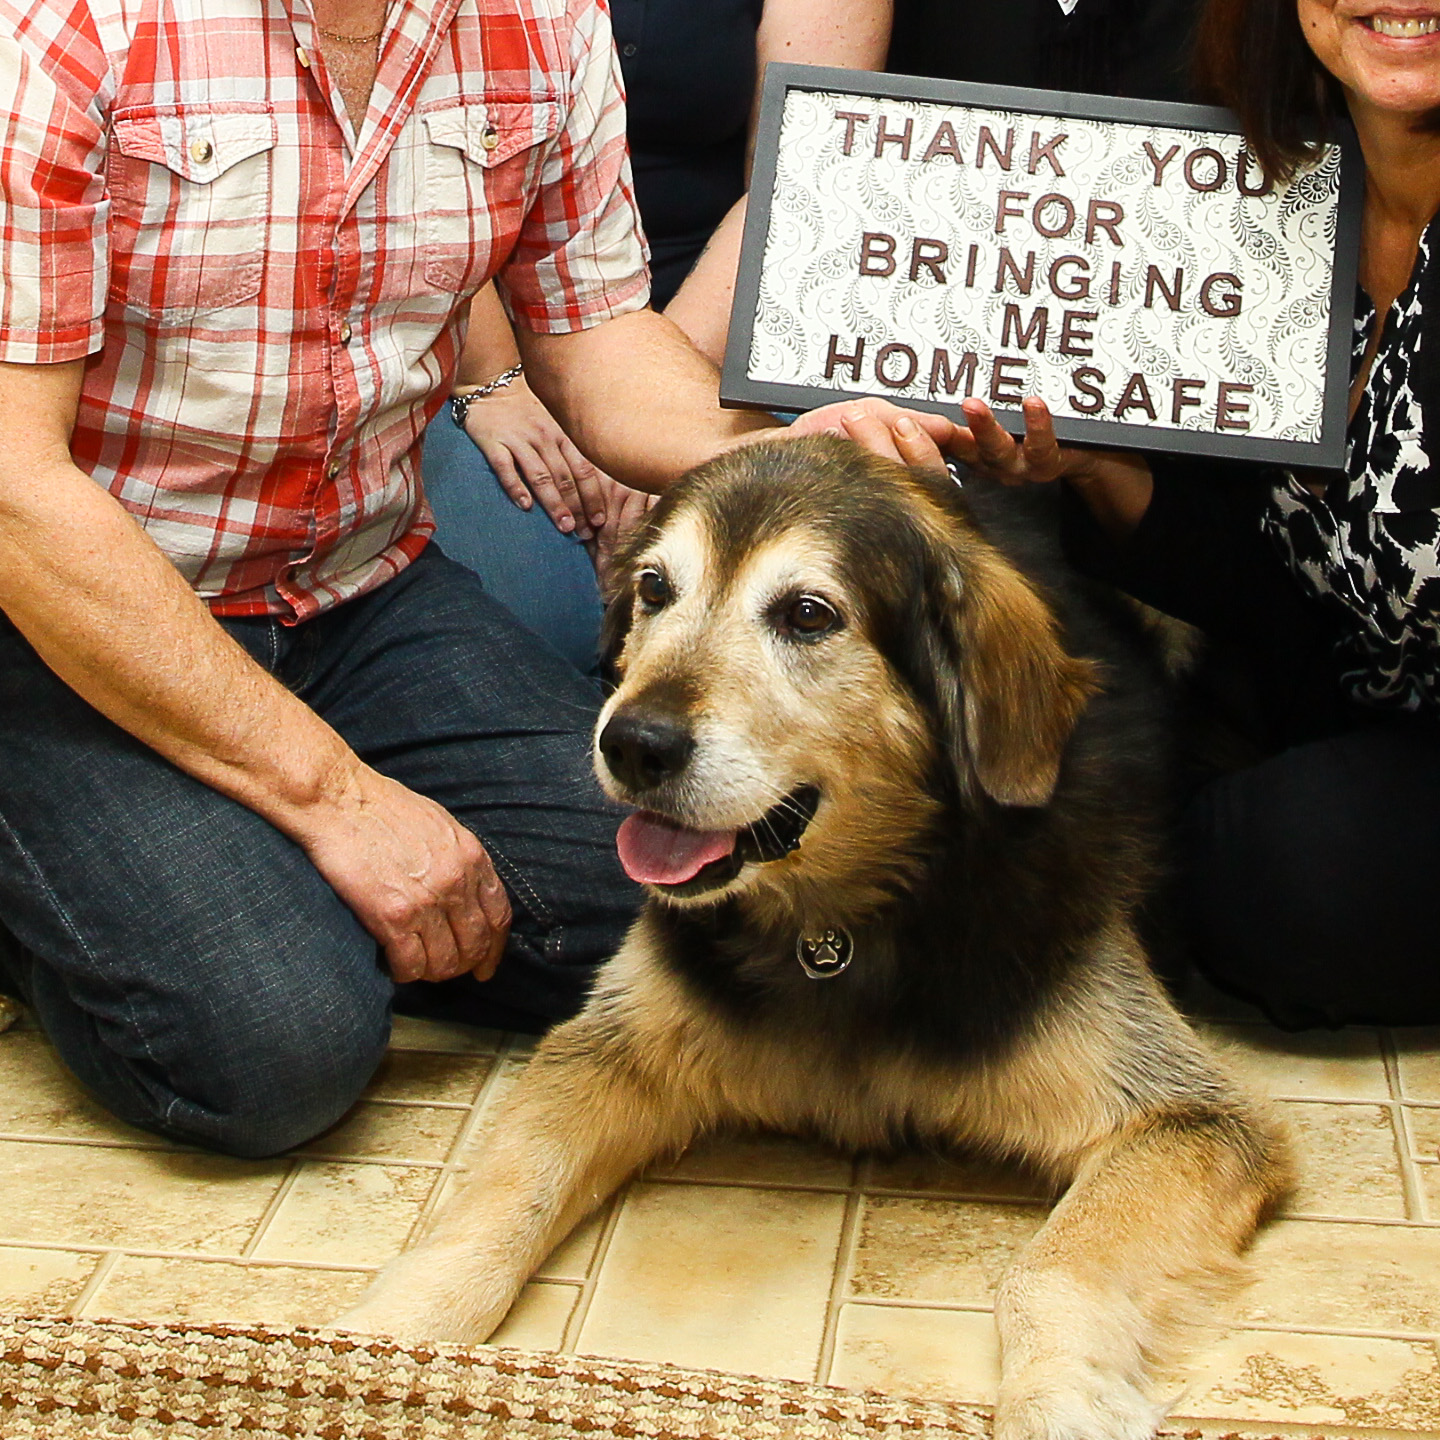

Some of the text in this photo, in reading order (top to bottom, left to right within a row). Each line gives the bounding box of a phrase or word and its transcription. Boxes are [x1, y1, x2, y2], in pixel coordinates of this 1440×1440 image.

[833, 111, 1276, 197] THANK YOU
[994, 191, 1125, 247] FOR
[858, 231, 1244, 319] BRINGING
[1000, 303, 1098, 357] ME
[823, 334, 1255, 431] HOME SAFE
